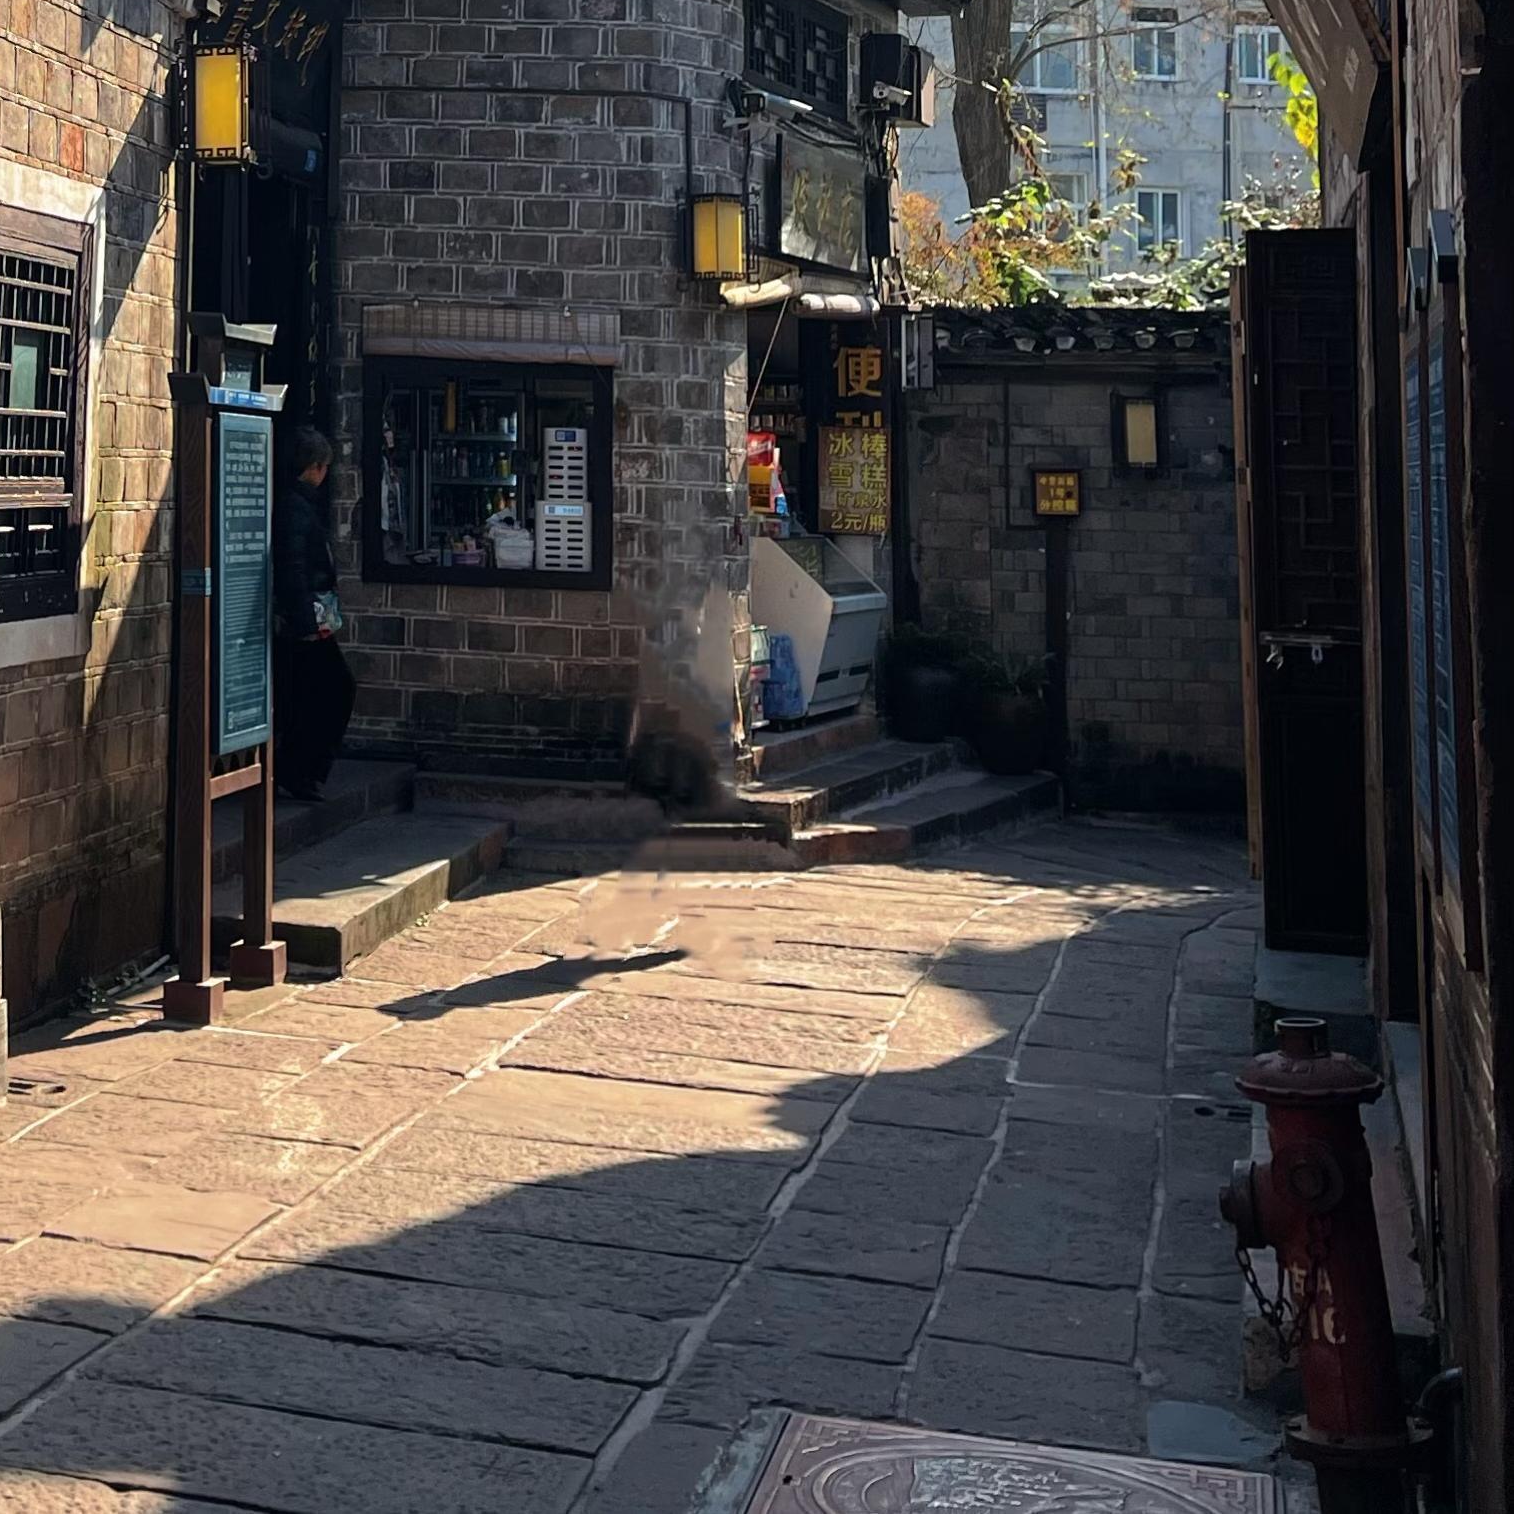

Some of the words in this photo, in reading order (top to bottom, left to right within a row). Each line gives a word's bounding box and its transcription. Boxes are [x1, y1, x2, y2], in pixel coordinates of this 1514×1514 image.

[829, 433, 887, 459] 冰棒
[828, 462, 887, 489] 雪糕
[837, 491, 887, 509] 矿泉水
[831, 510, 887, 532] 2元/瓶
